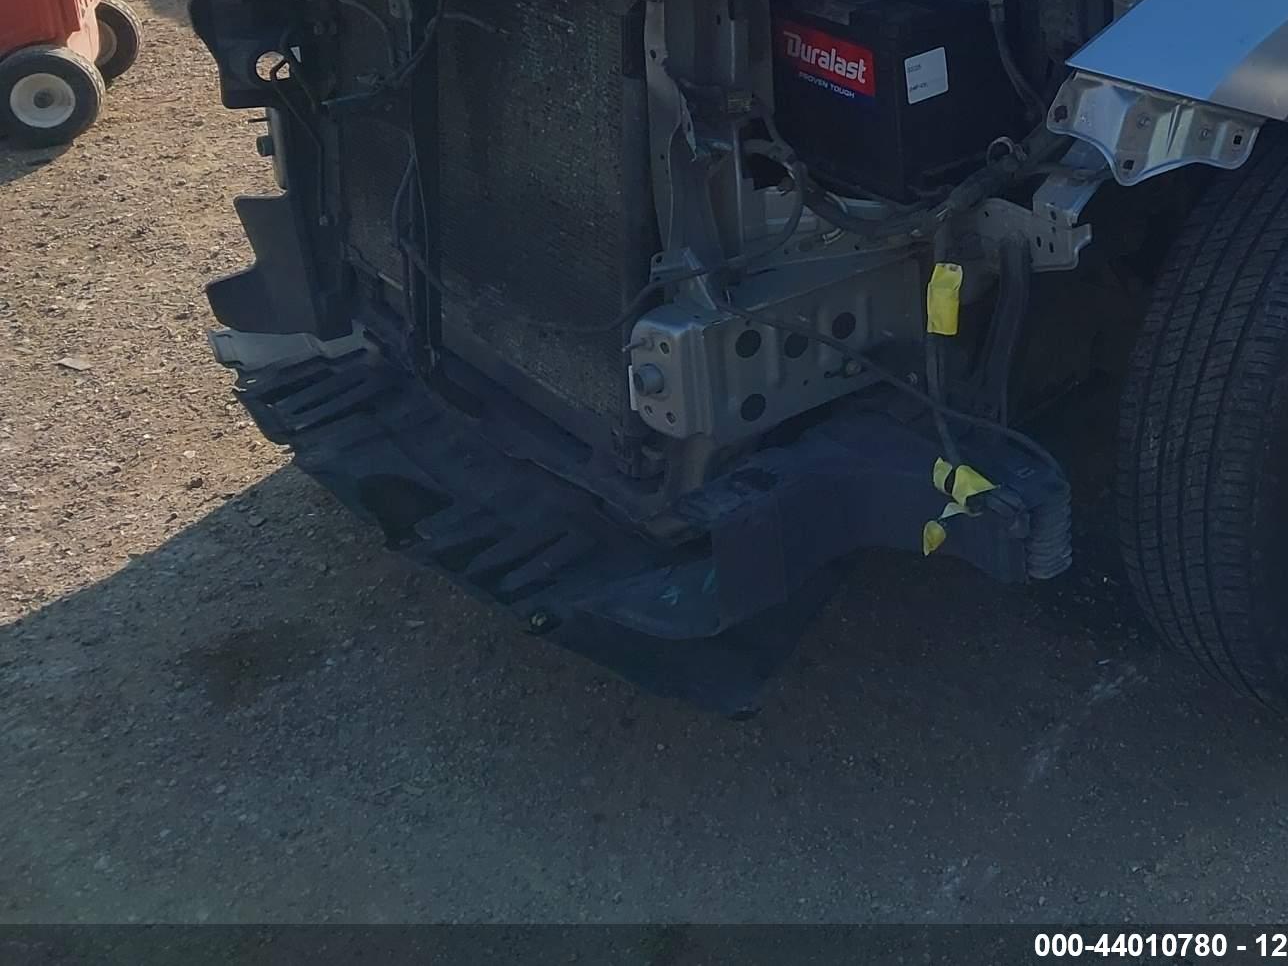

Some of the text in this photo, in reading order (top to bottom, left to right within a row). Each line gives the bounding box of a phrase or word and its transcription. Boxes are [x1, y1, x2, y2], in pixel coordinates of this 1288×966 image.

[783, 29, 867, 84] Duralast
[798, 70, 856, 100] PROVEN TOUGH
